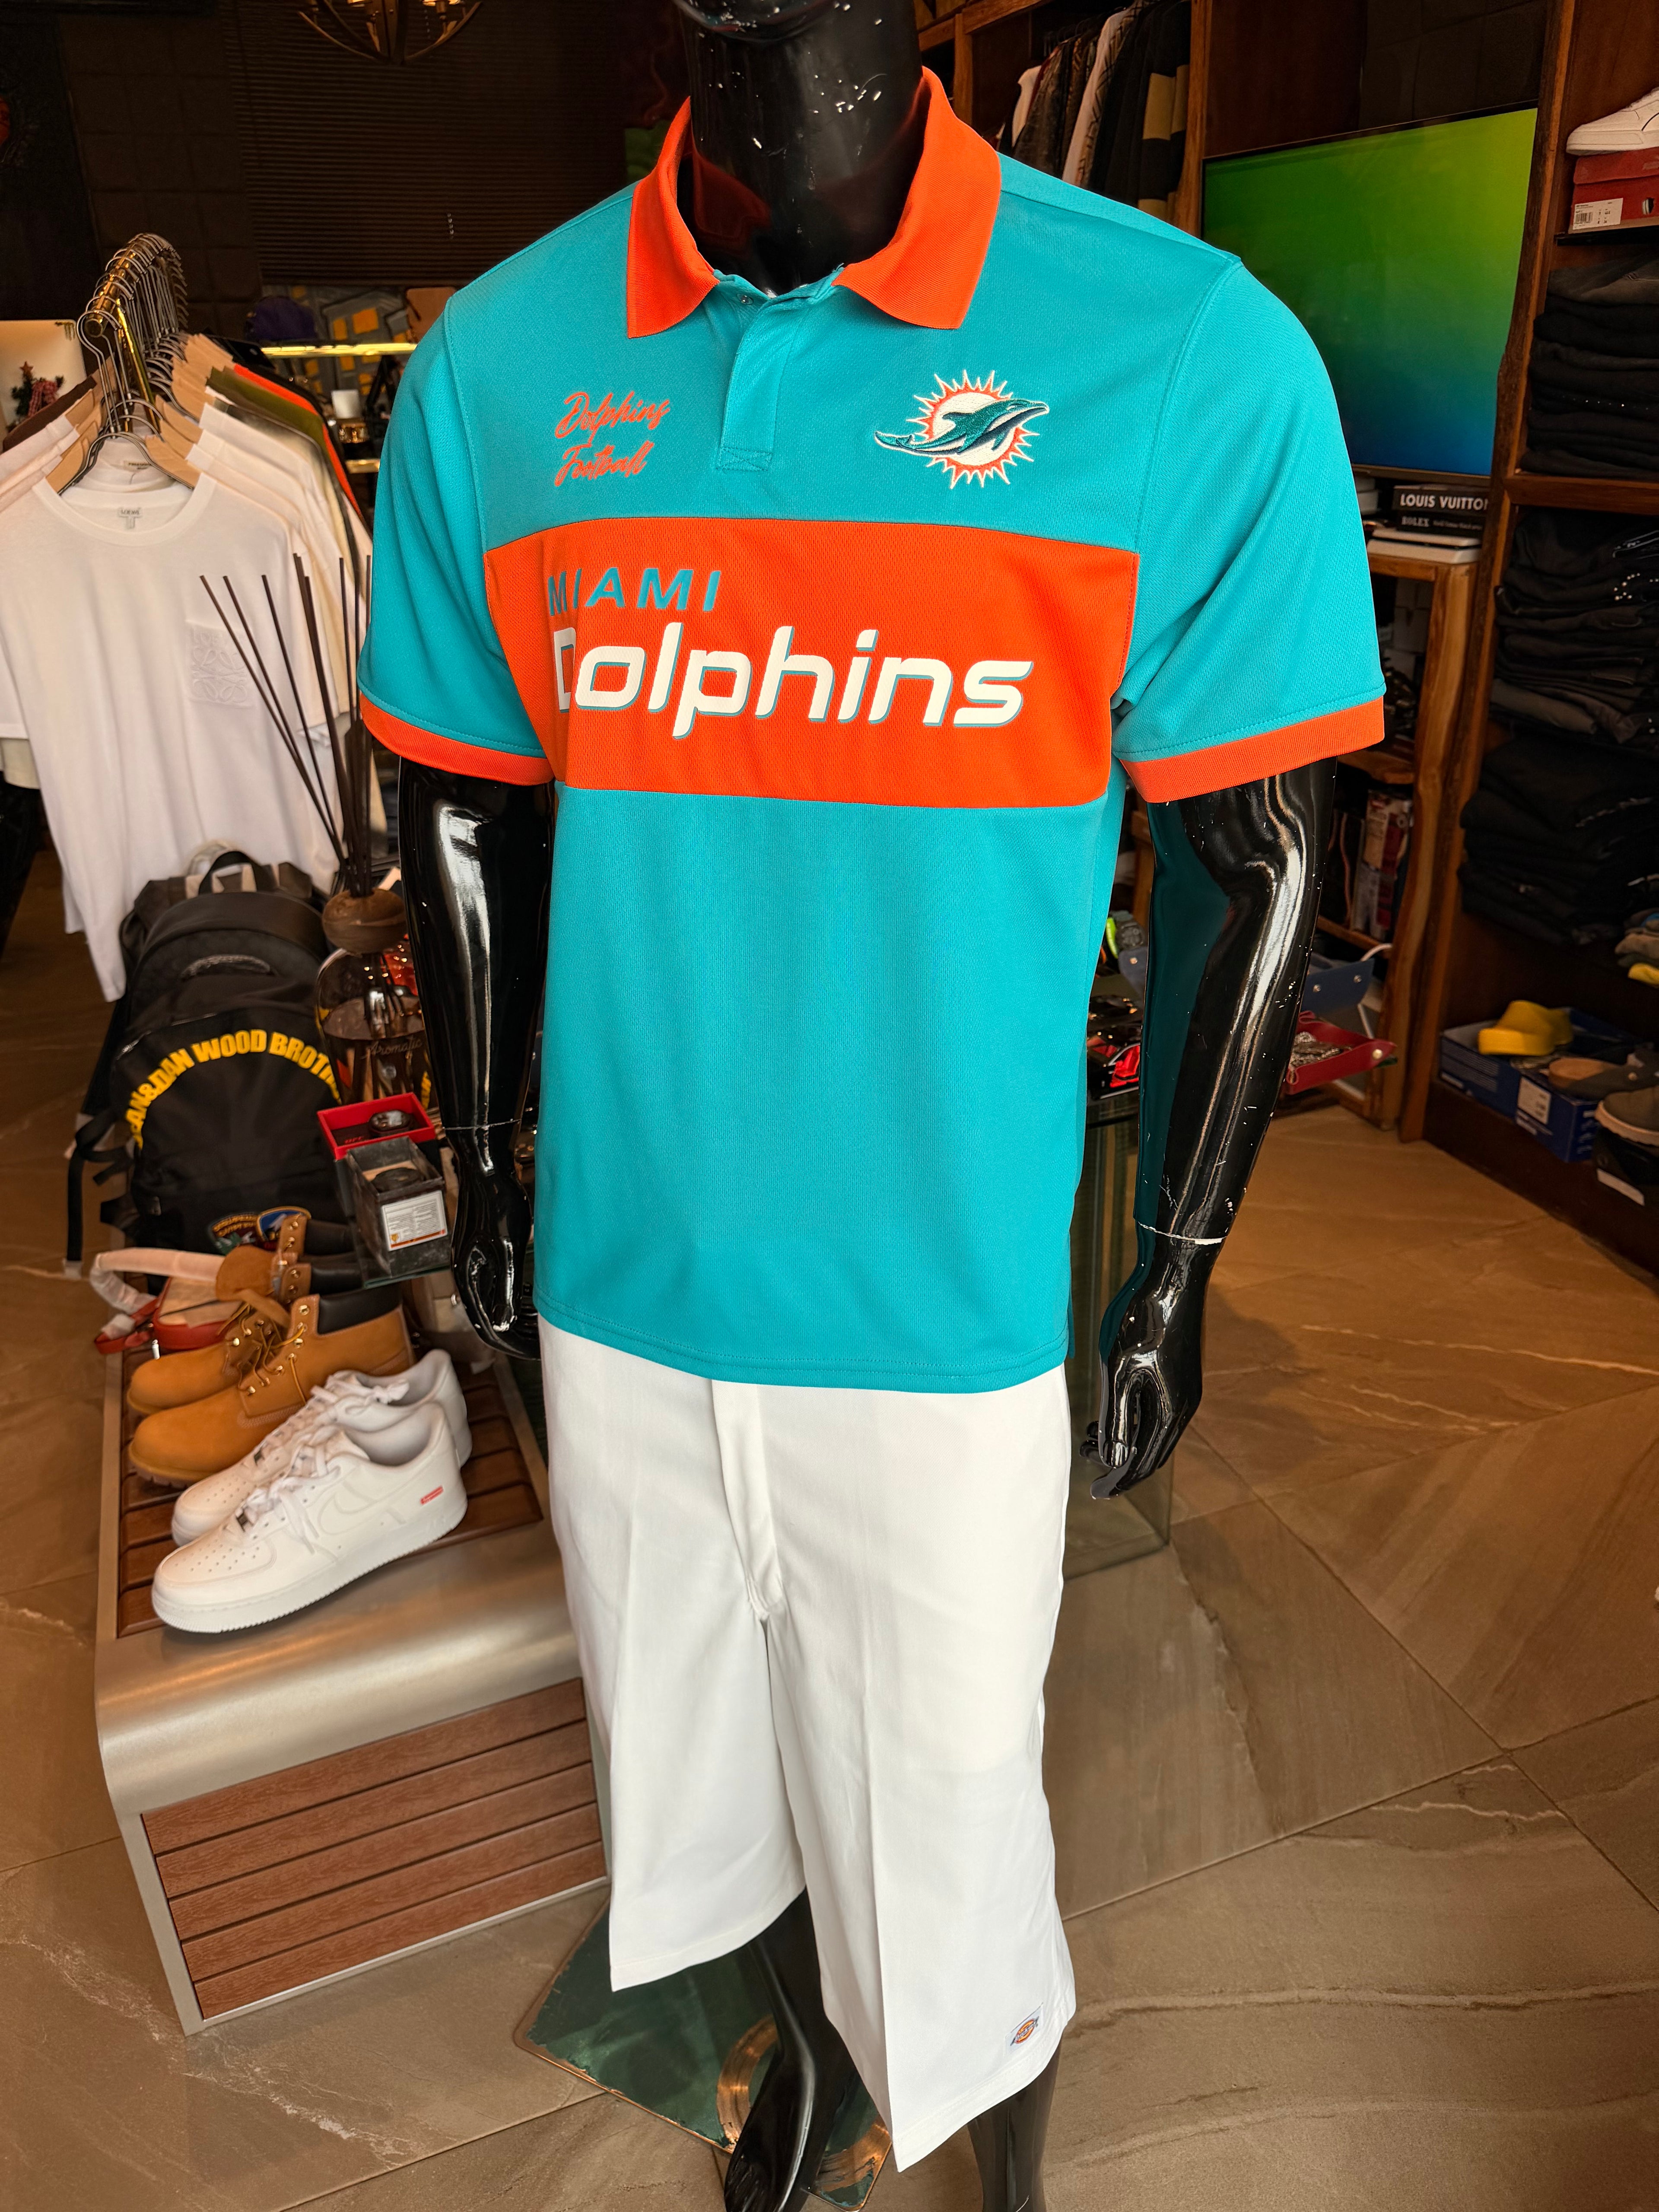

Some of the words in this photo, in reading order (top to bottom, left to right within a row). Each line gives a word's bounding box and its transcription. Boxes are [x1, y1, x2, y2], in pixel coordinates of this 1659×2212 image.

[555, 391, 670, 447] Dolphins
[555, 440, 655, 487] Football
[1400, 494, 1435, 508] LOUIS
[548, 567, 721, 616] MIAMI
[554, 622, 1034, 739] Dolphins
[191, 1029, 267, 1063] WOOD
